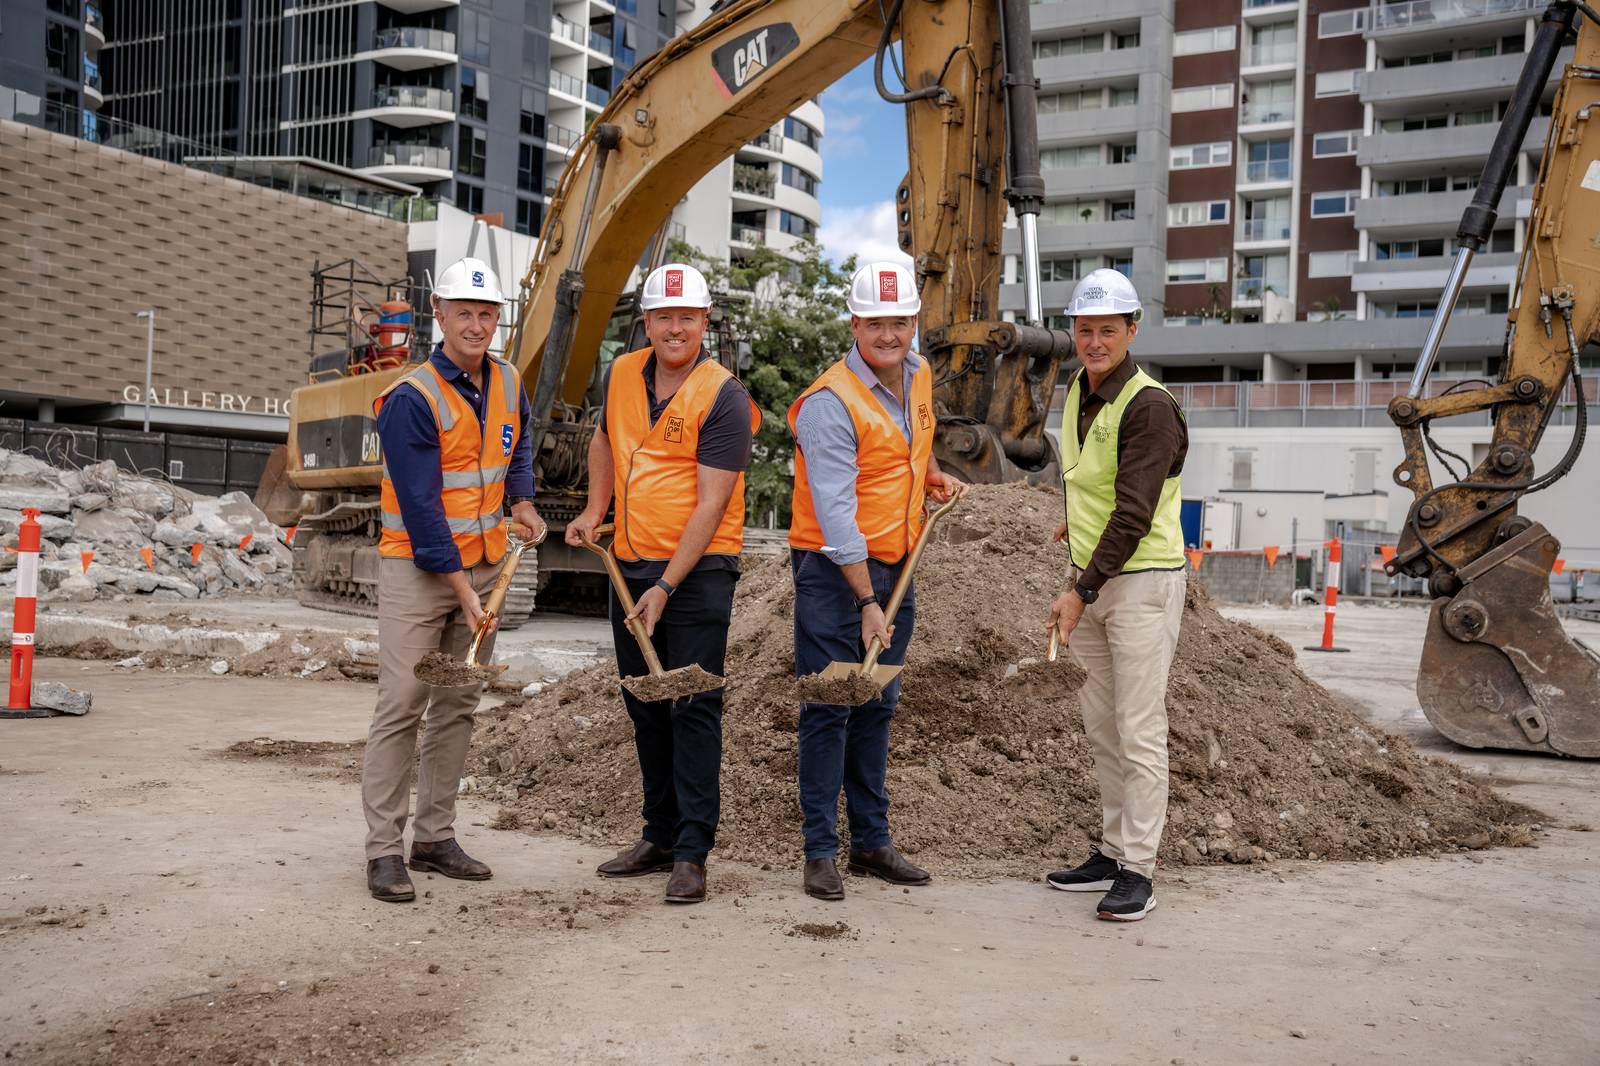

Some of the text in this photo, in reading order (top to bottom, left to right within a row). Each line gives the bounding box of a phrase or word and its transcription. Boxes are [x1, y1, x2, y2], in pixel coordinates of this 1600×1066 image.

[733, 28, 769, 87] CAT
[123, 385, 252, 412] GALLERY
[669, 418, 681, 427] Red
[361, 432, 380, 462] CAT
